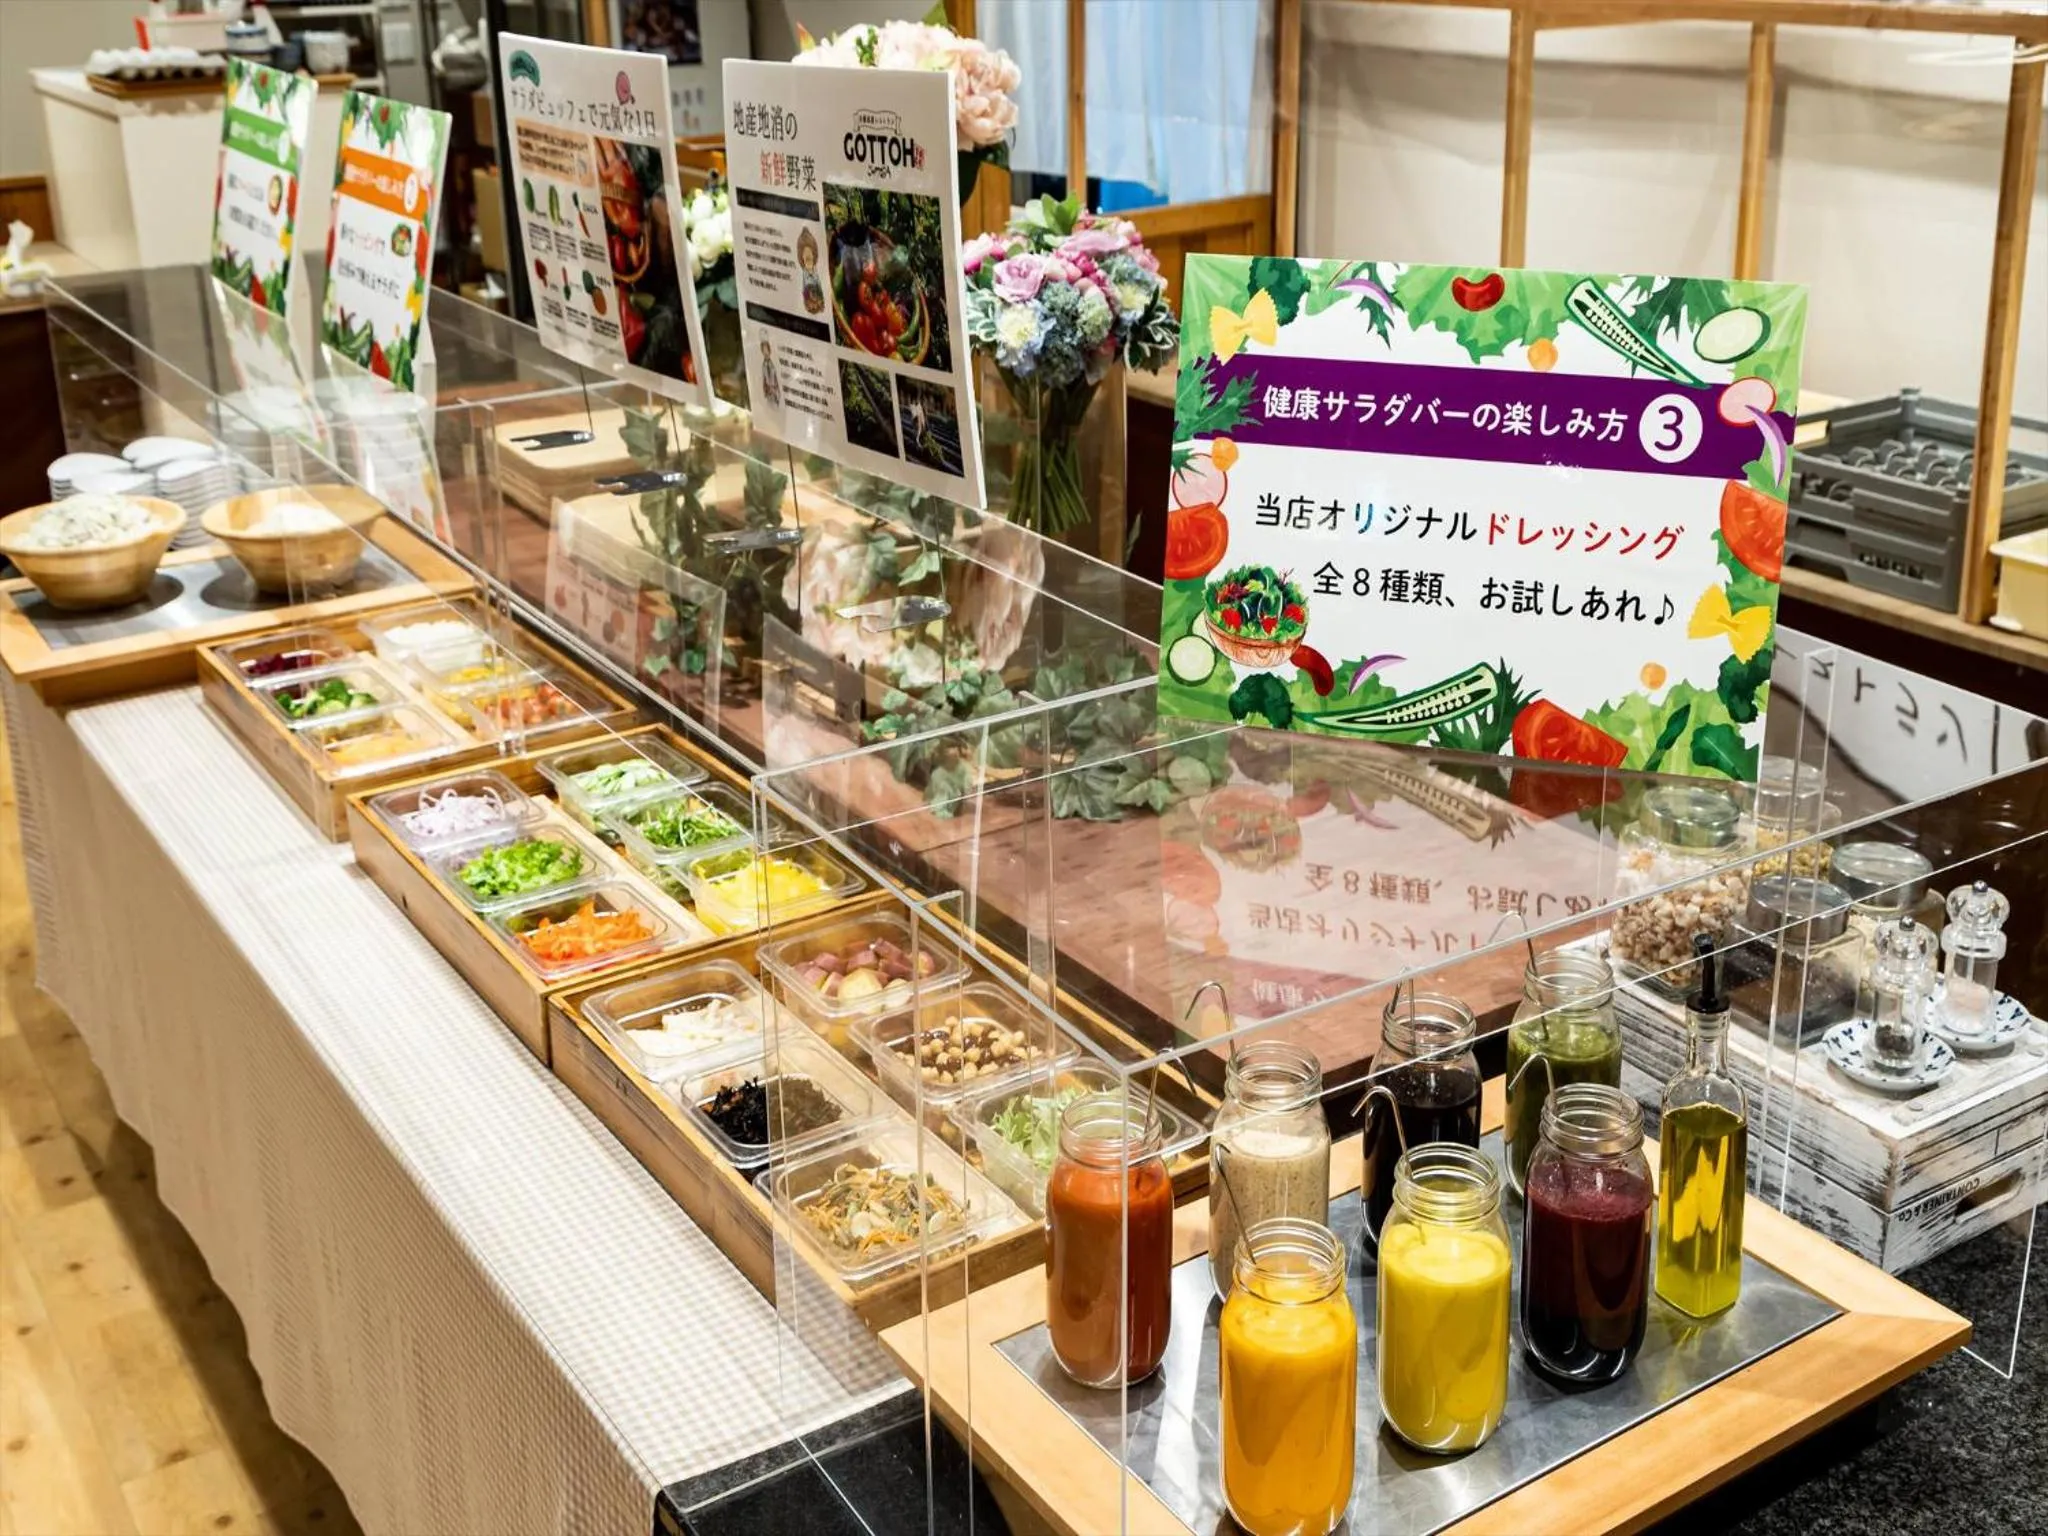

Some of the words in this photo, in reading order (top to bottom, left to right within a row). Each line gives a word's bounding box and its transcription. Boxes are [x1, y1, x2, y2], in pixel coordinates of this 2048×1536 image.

[733, 101, 798, 141] 地産地消の
[760, 151, 817, 192] 新鮮野菜
[1263, 384, 1628, 442] 健康サラダバーの楽しみ方
[1255, 492, 1685, 561] 当店オリジナルドレッシング
[1921, 1178, 1980, 1213] CONTAINER
